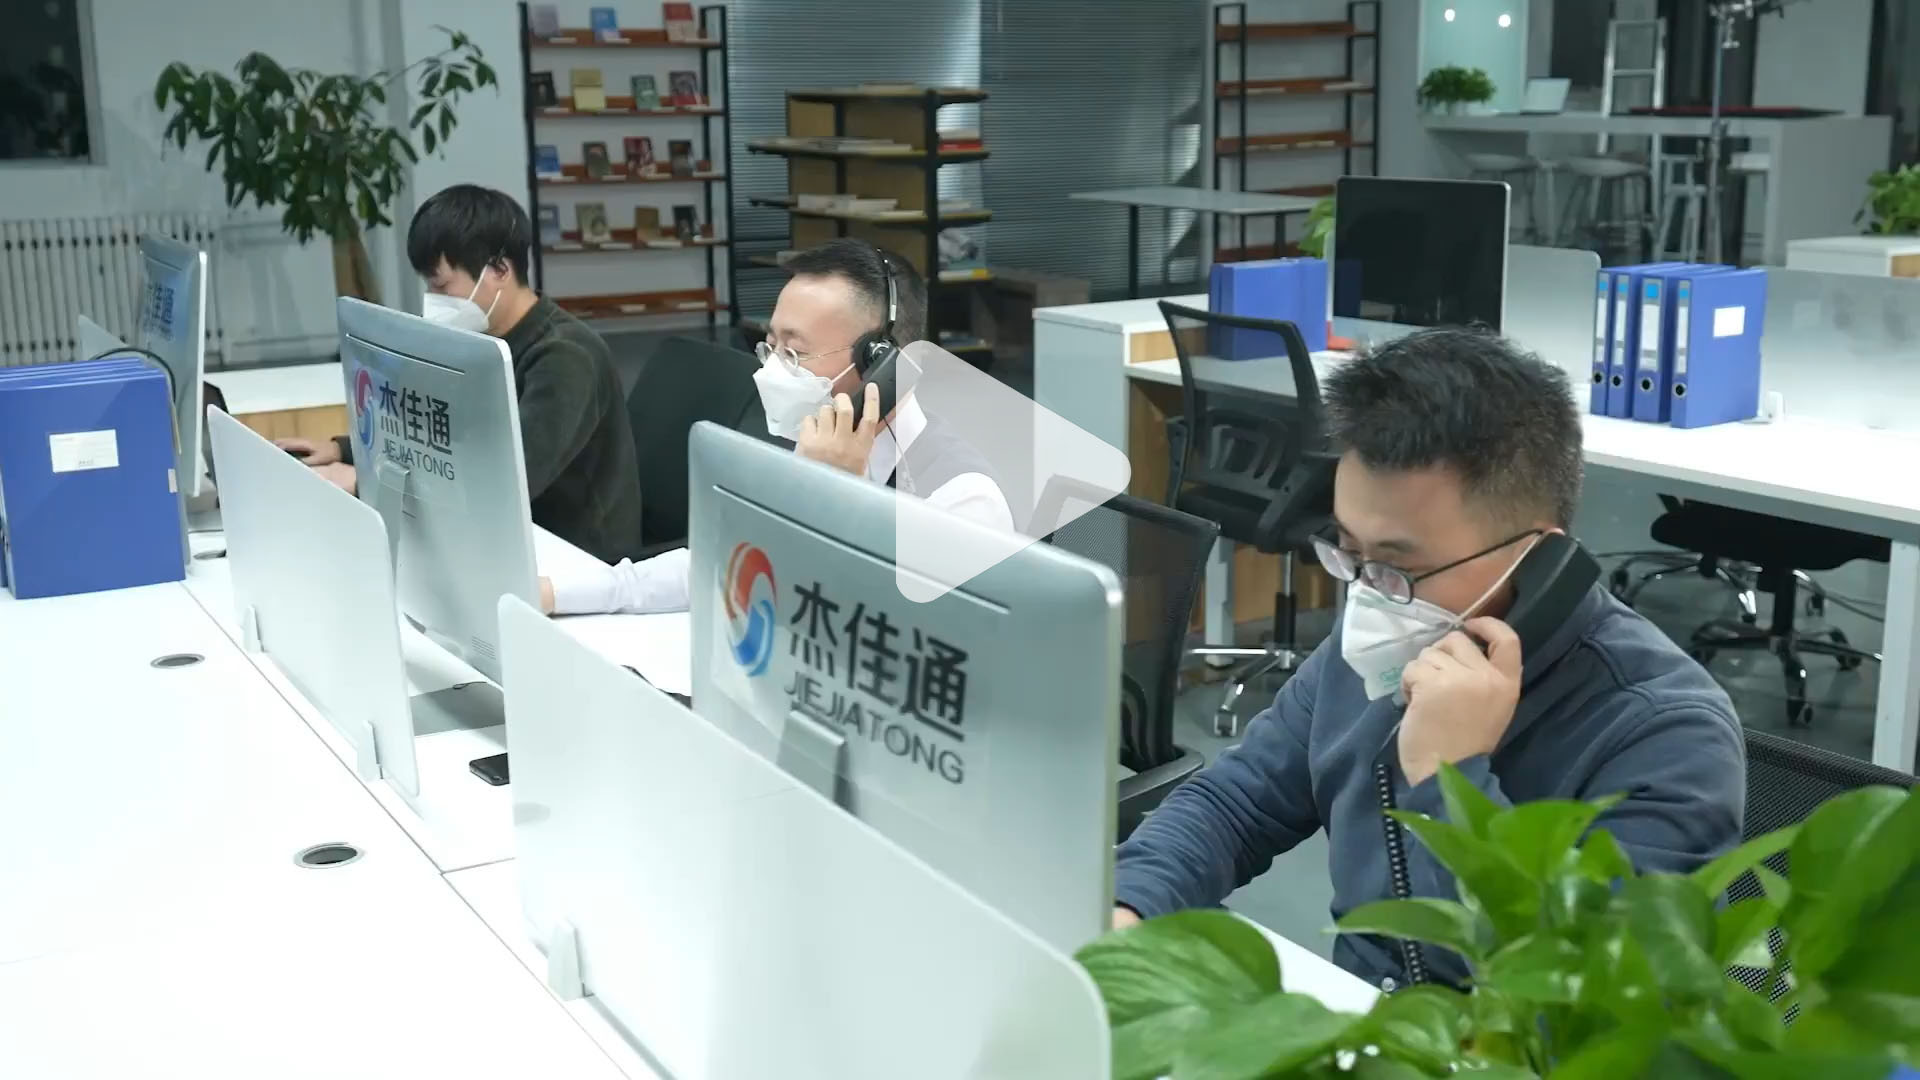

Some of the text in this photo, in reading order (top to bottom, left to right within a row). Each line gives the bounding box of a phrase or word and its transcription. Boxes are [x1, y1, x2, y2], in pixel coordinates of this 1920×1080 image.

[379, 381, 452, 455] 杰佳通
[382, 438, 455, 480] JIEJIATONG
[790, 581, 968, 742] 杰佳通
[785, 671, 964, 784] JIEJIATONG
